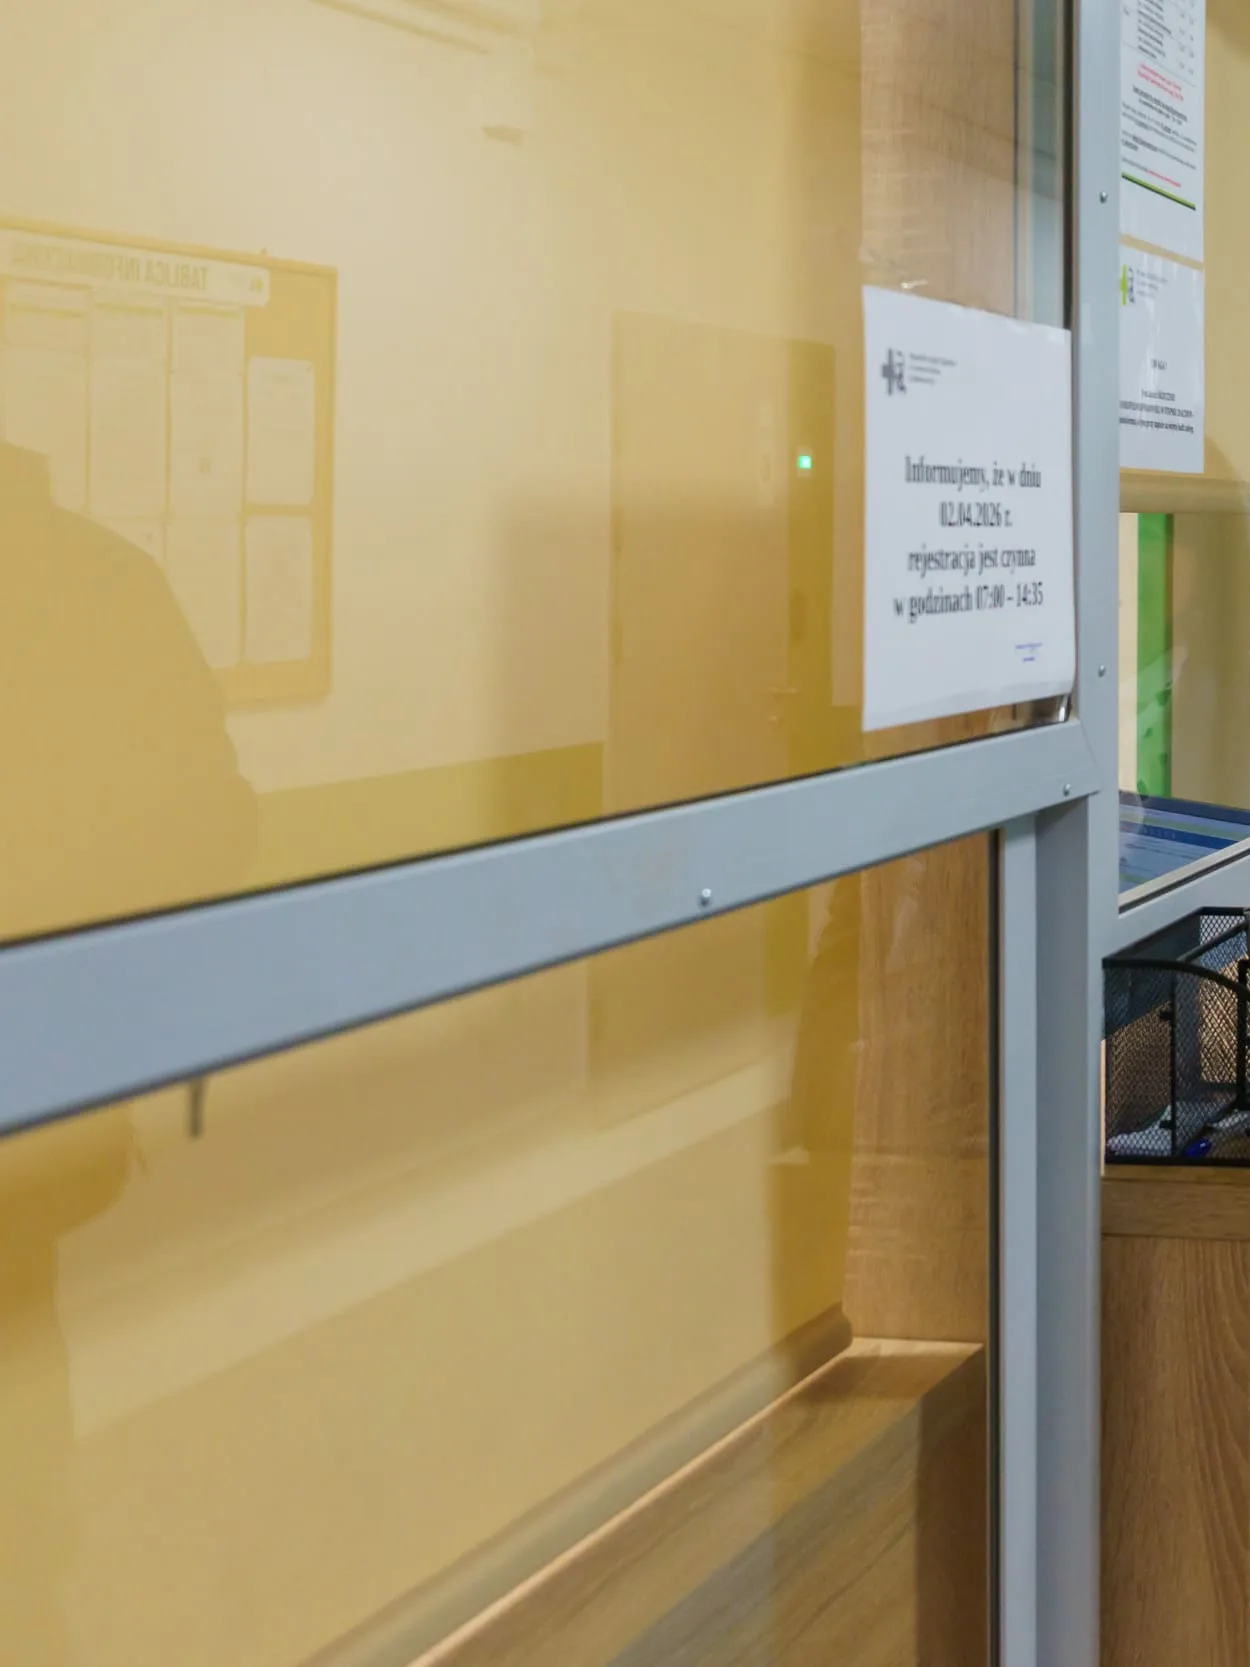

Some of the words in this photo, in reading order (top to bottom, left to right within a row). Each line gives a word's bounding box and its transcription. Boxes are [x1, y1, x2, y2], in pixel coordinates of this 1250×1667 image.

[905, 455, 990, 492] Informujemy,
[992, 460, 1004, 486] że
[1007, 468, 1015, 485] w
[1020, 461, 1042, 488] dniu
[940, 501, 1002, 528] 02.04.2026
[908, 543, 976, 579] rejestracja
[977, 542, 998, 576] jest
[1001, 548, 1036, 575] czynna
[894, 597, 904, 617] w
[908, 585, 973, 624] godzinach
